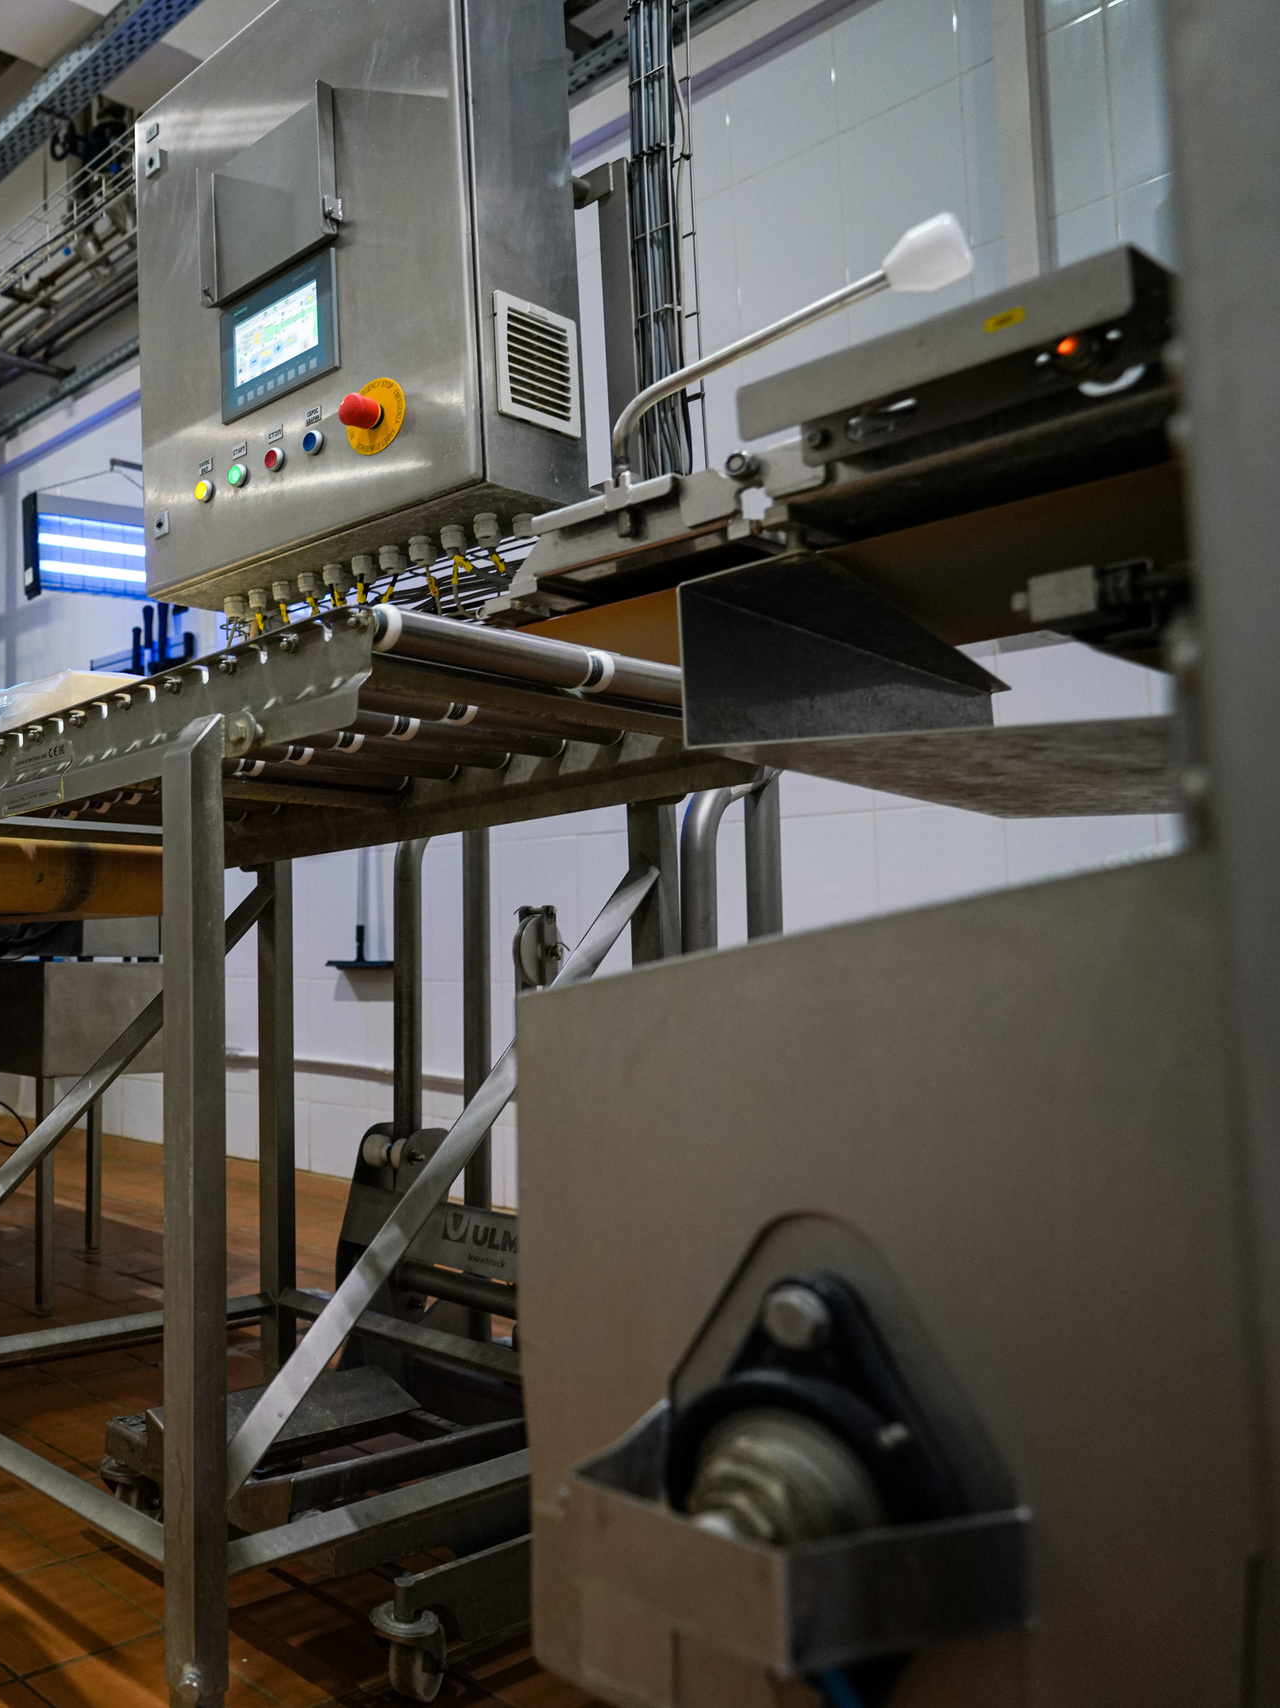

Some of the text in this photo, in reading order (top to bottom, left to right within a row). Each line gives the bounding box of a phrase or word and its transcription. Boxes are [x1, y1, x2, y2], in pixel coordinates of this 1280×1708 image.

[268, 429, 282, 440] СТОП
[232, 445, 246, 457] СТАРТ
[467, 1253, 505, 1268] Inoxtruck
